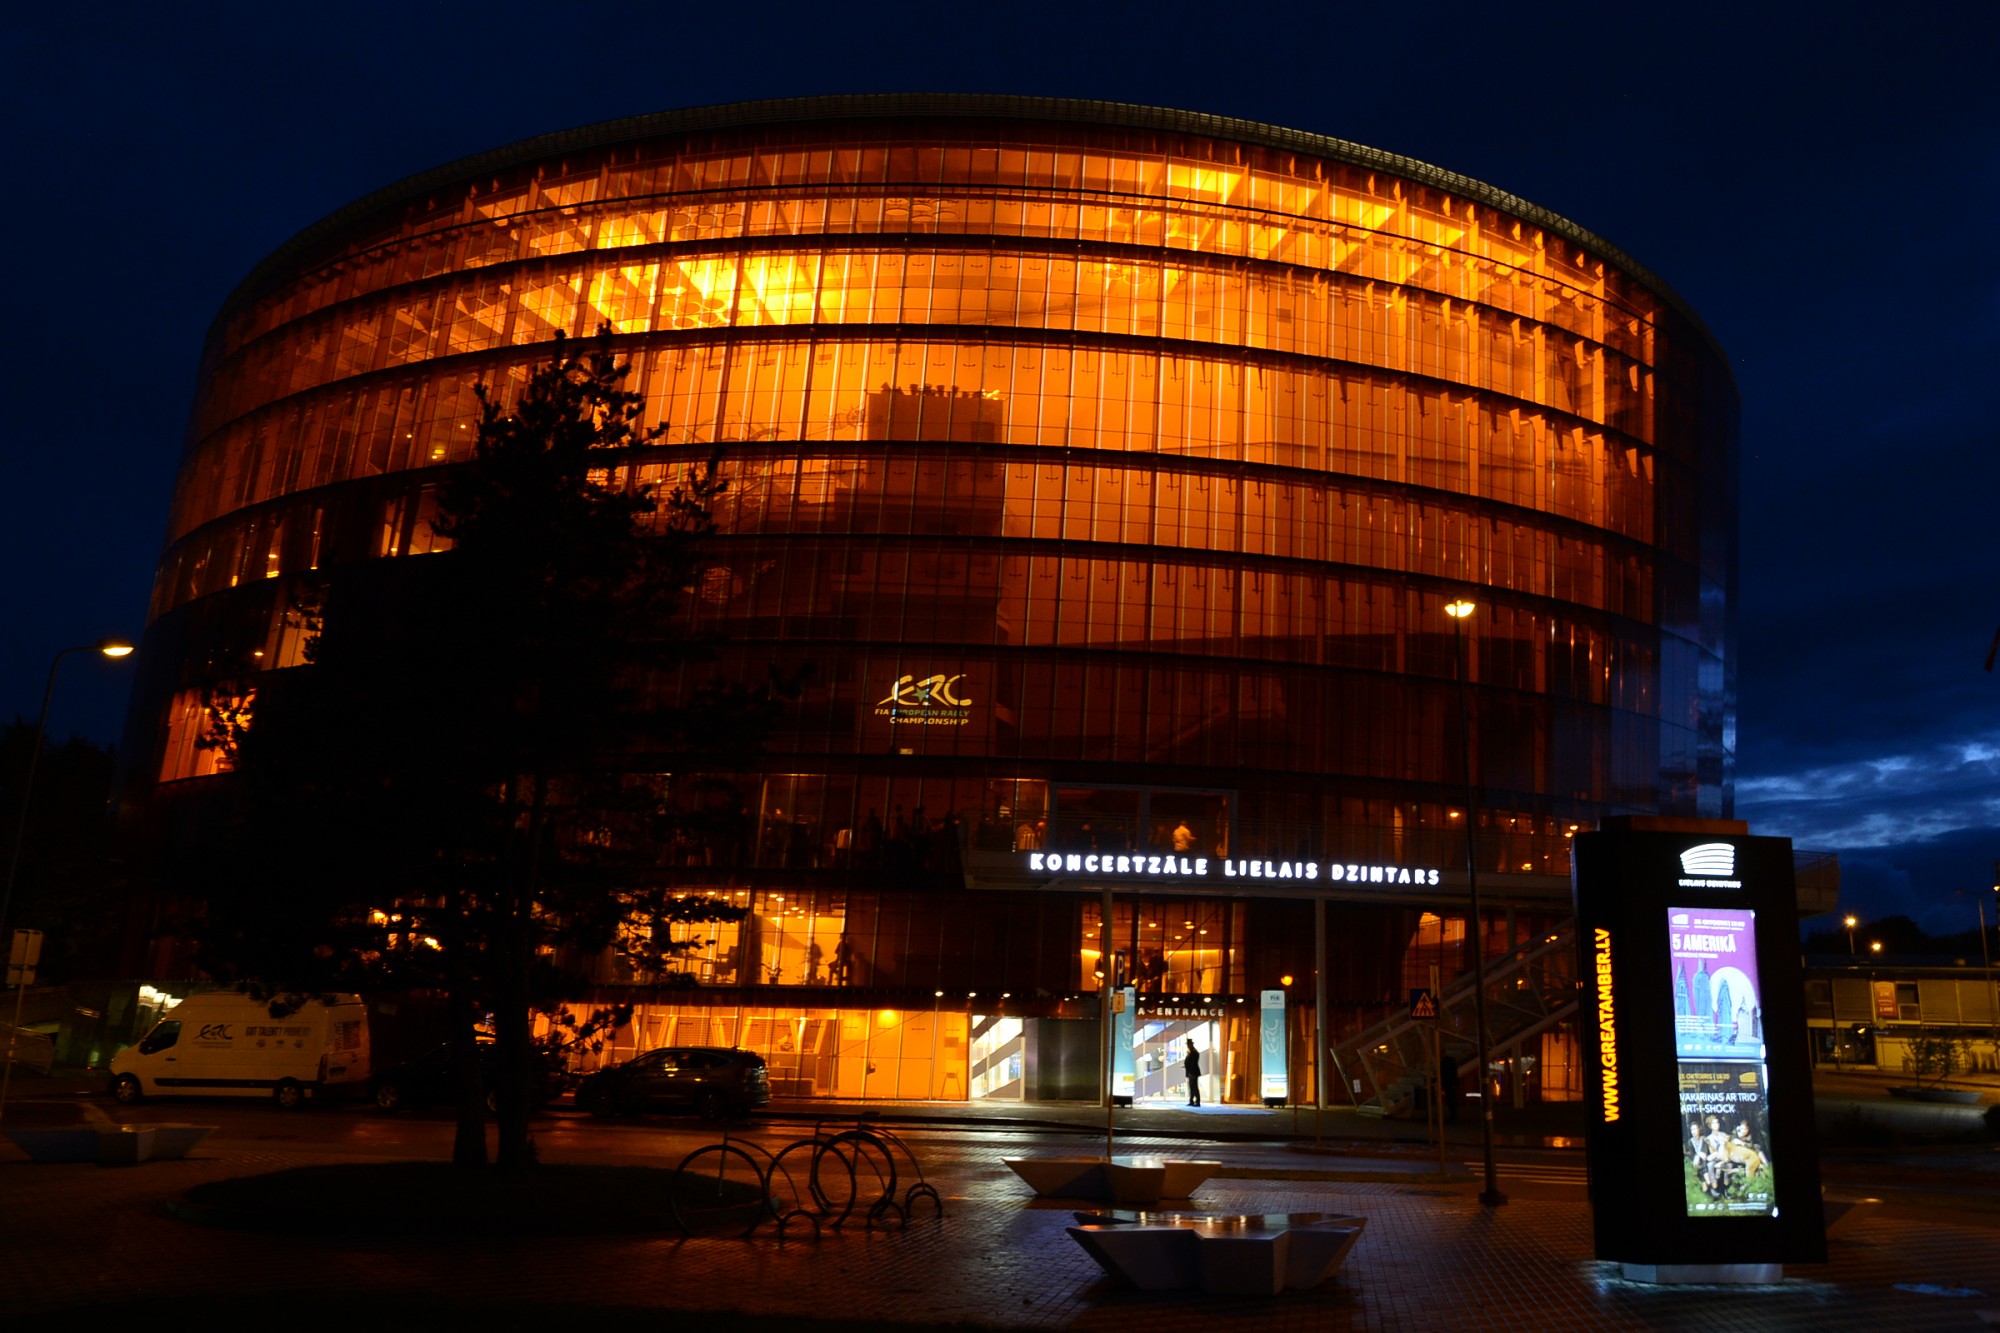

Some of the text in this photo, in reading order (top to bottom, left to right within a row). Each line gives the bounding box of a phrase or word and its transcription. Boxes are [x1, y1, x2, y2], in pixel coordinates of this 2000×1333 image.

[892, 708, 938, 717] EROPEAN
[1029, 852, 1441, 886] KONCERTZĀLE LIELAIS DZINTARS
[1672, 933, 1737, 954] 5 AMERIKĀ
[1156, 1007, 1225, 1018] ENTRANCE
[1595, 928, 1620, 1122] WWW.GREATAMBER.LV
[1725, 1093, 1737, 1102] AR
[1738, 1093, 1758, 1102] TRIO
[1681, 1104, 1736, 1114] ART-I-SHOCK
